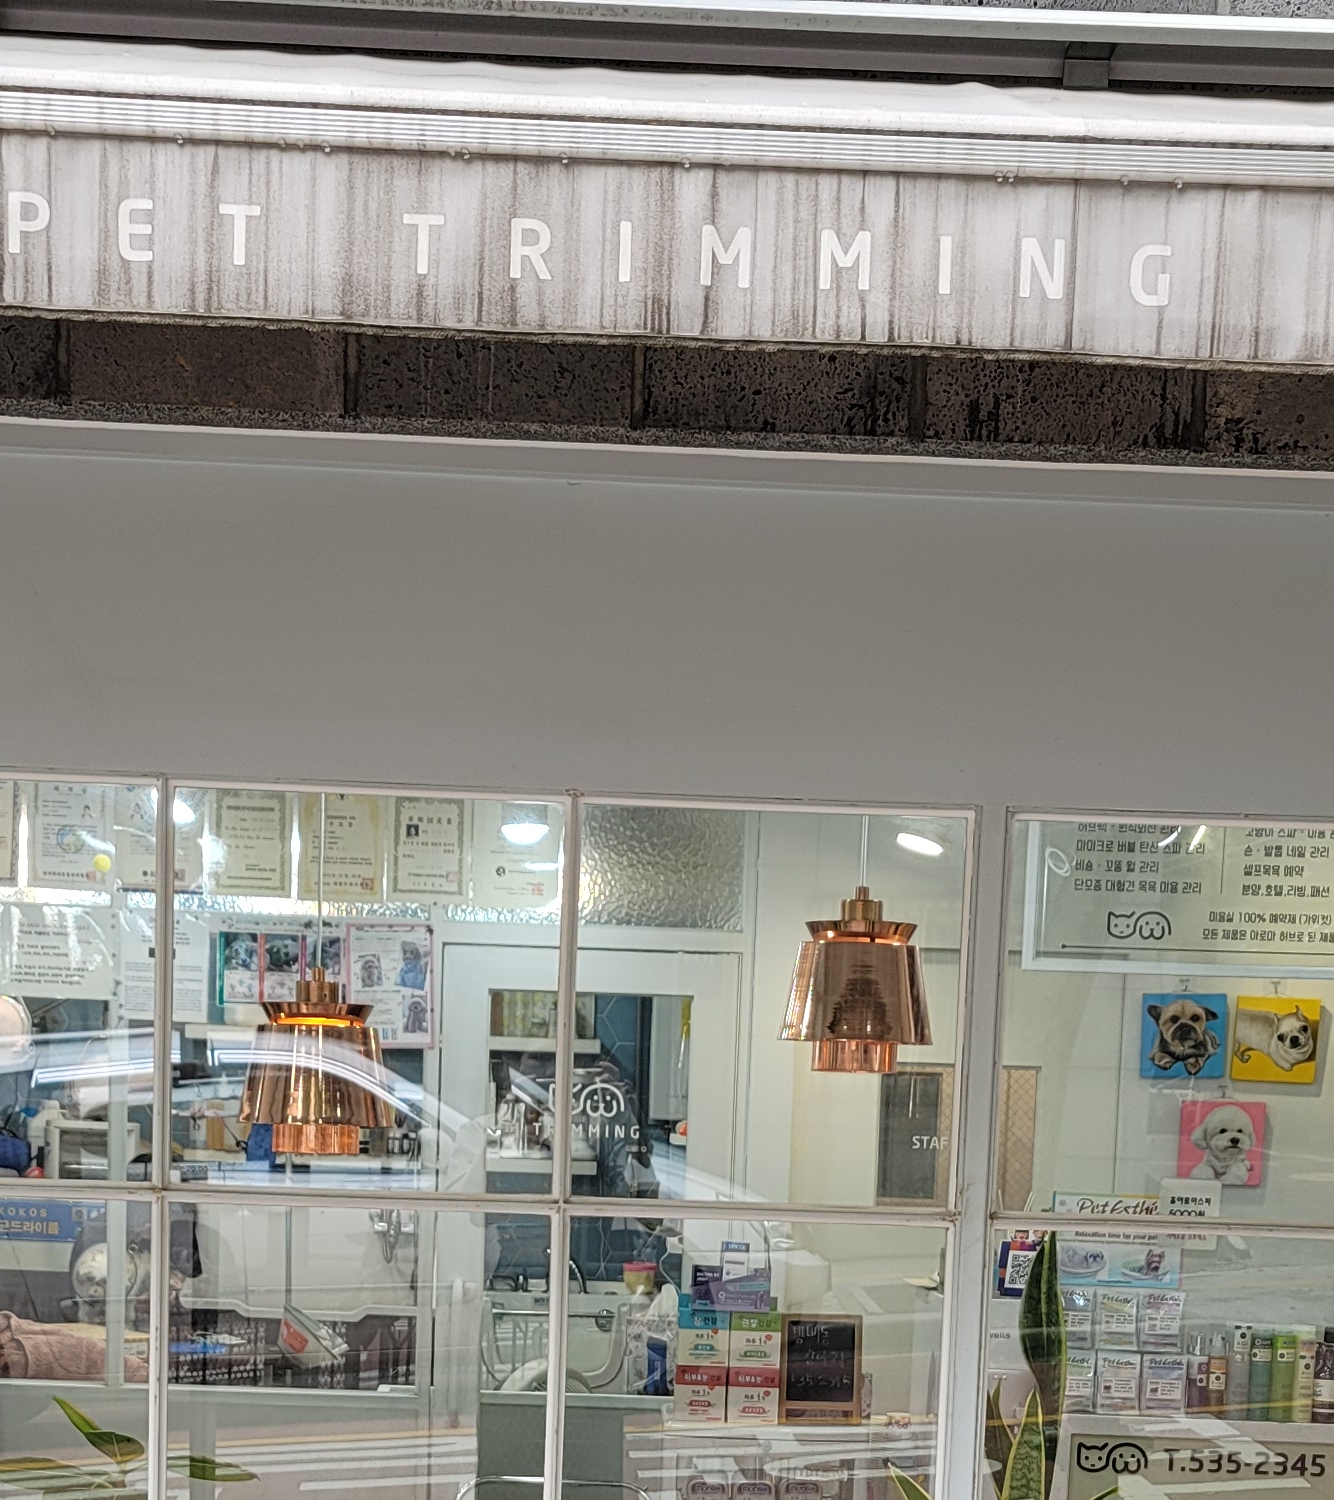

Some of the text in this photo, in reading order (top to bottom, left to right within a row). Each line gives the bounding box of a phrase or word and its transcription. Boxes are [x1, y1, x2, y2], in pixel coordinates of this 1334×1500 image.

[8, 190, 1174, 308] PET TRIMMING
[1076, 838, 1114, 853] 마이크로
[1117, 840, 1136, 853] 버블
[1286, 845, 1307, 858] 네일
[1310, 846, 1330, 859] 관리
[1139, 860, 1159, 874] 관리
[1243, 863, 1305, 878] 셀프목욕 예약
[1074, 878, 1202, 895] 단모종 대형견 목욕 미용 관리
[1208, 911, 1332, 926] 미용실 100% 예약제 (가위컷)
[1202, 928, 1218, 940] 모든
[1221, 929, 1247, 941] 제품은
[1249, 930, 1276, 941] 아로마
[1279, 930, 1305, 943] 허브로
[1307, 931, 1317, 943] 된
[532, 1121, 641, 1140] TRMMING
[911, 1135, 952, 1150] STAF
[1077, 1197, 1110, 1214] Pet
[1122, 1232, 1131, 1240] for
[1164, 1448, 1326, 1477] T.535-2345
